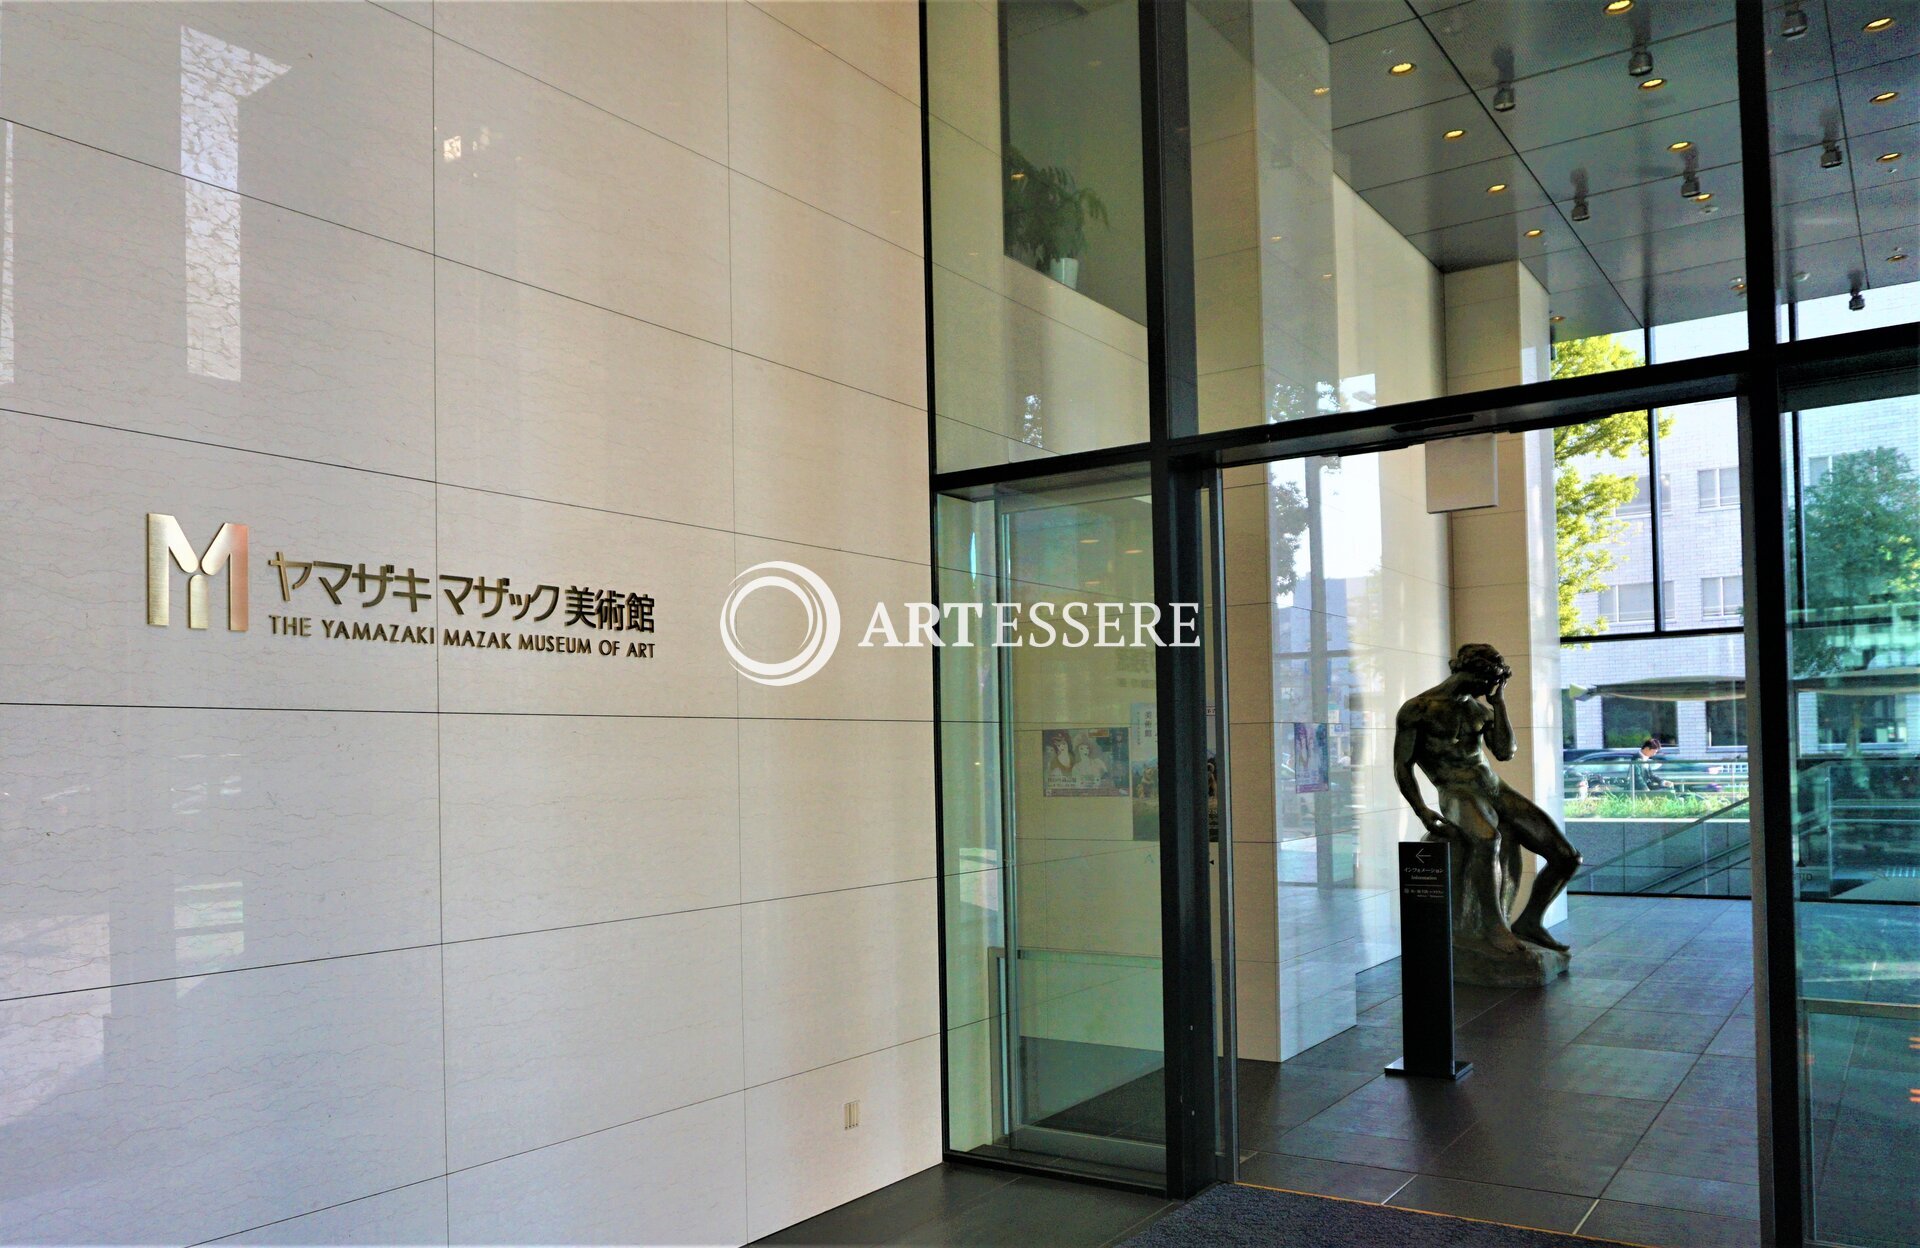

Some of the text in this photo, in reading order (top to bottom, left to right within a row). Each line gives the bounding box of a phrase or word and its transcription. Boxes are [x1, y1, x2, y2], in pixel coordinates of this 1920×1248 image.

[269, 615, 655, 658] THE YAMAZAKI MAZAK MUSEUM OF ART
